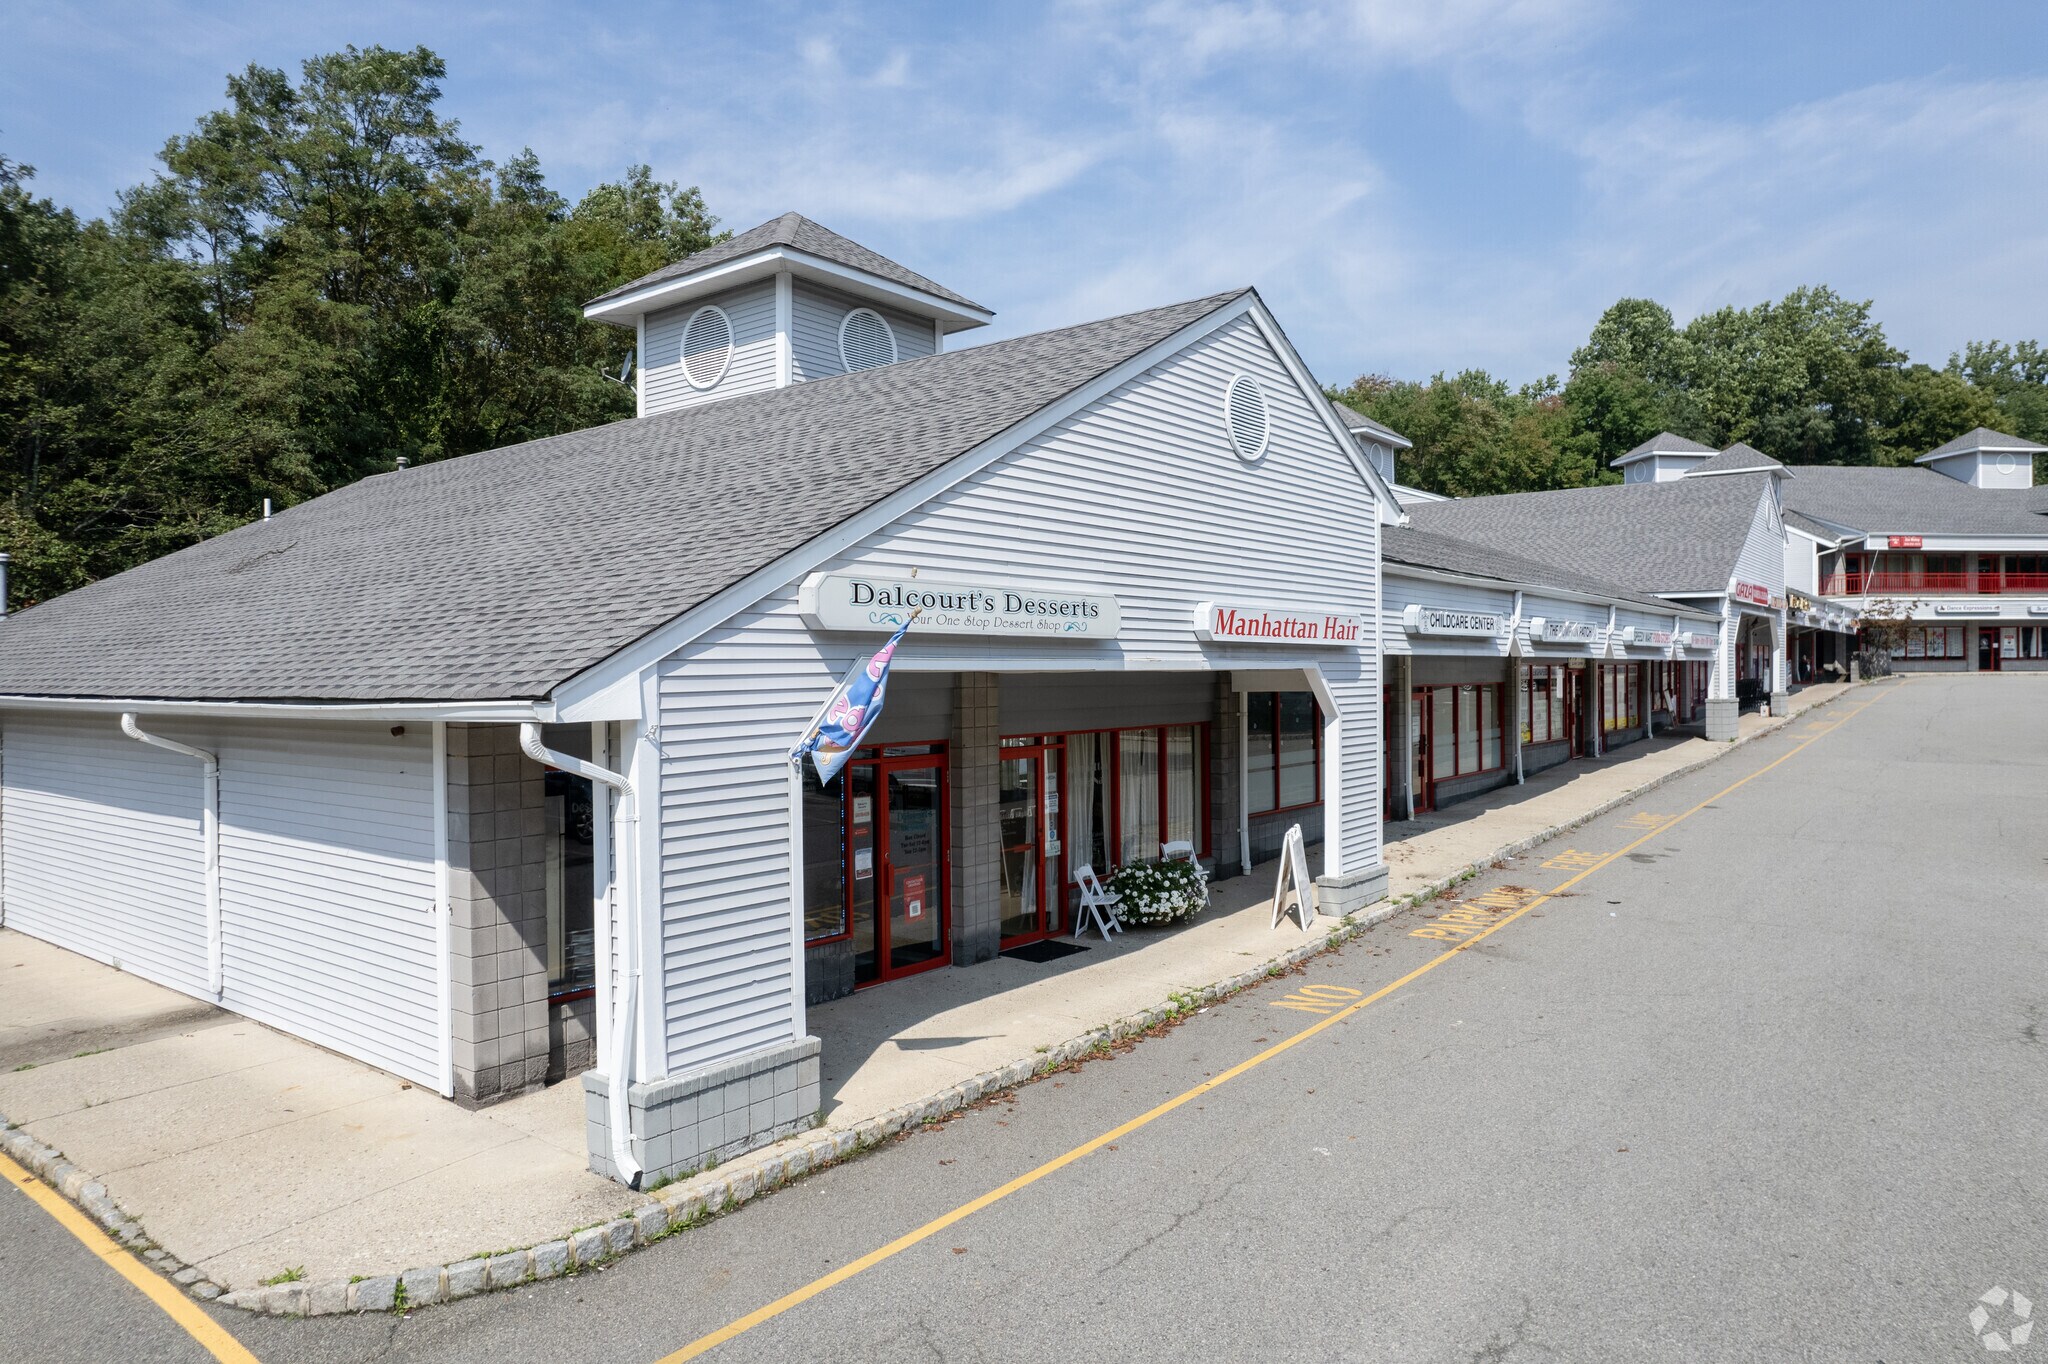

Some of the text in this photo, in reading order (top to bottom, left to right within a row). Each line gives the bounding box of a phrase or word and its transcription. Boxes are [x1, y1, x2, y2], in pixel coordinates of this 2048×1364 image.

[851, 582, 1098, 617] Dalcourt's Desserts
[936, 614, 960, 626] One
[964, 615, 990, 630] Stop
[994, 617, 1034, 629] Dessert
[1036, 619, 1061, 633] Shop
[1214, 608, 1359, 640] Manhattan Hair
[1430, 613, 1494, 630] CHILDCARE CENTER
[1540, 849, 1611, 871] FIRE
[1408, 887, 1540, 941] PARKING
[1269, 984, 1363, 1014] NO
